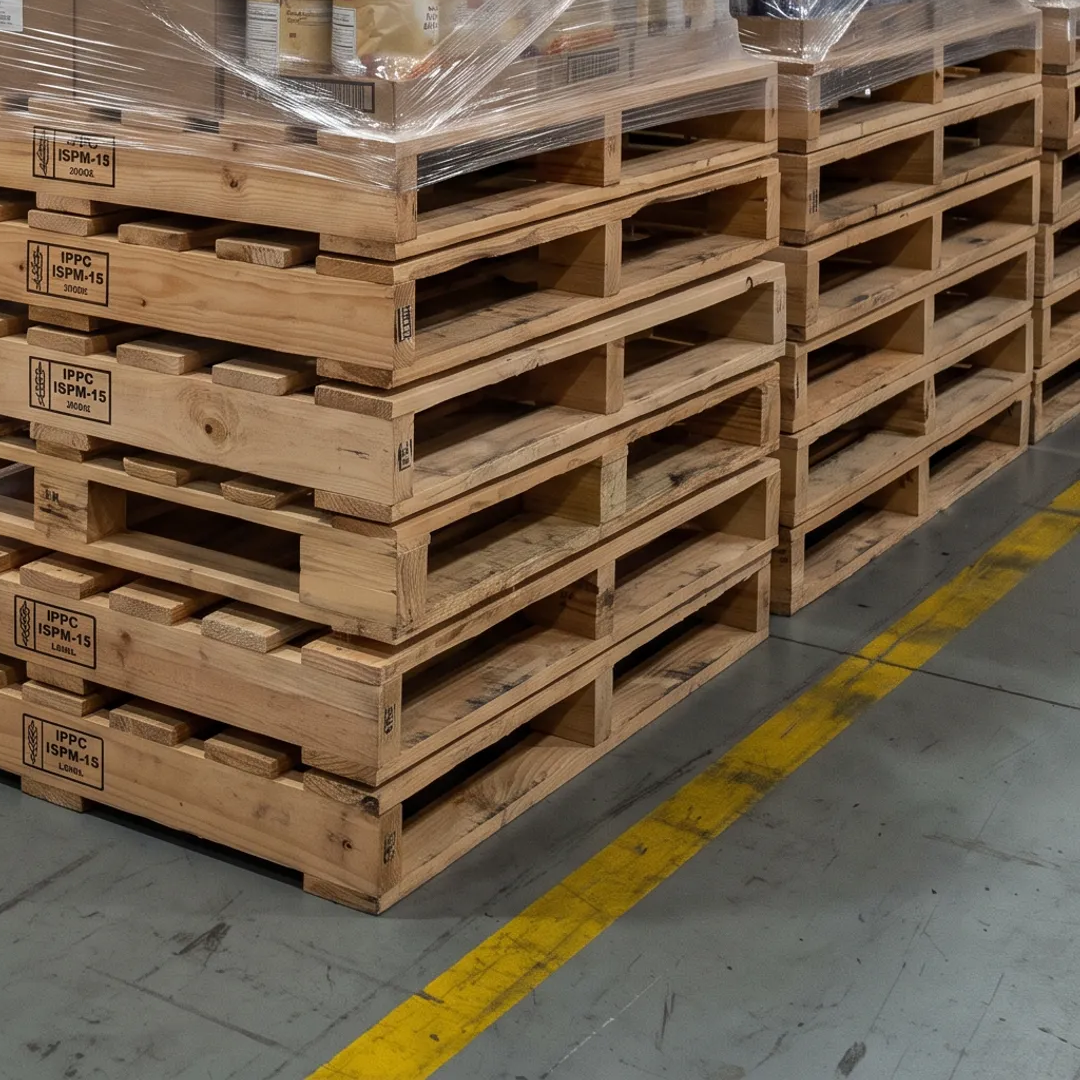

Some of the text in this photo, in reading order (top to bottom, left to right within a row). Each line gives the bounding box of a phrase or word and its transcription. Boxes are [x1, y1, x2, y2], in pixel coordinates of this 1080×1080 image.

[61, 251, 92, 268] IPPC
[52, 264, 104, 285] ISPM-15
[63, 368, 94, 385] IPPC
[53, 380, 107, 403] ISPM-15
[47, 609, 79, 629] IPPC
[38, 622, 91, 648] ISPM-15
[56, 729, 87, 750] IPPC
